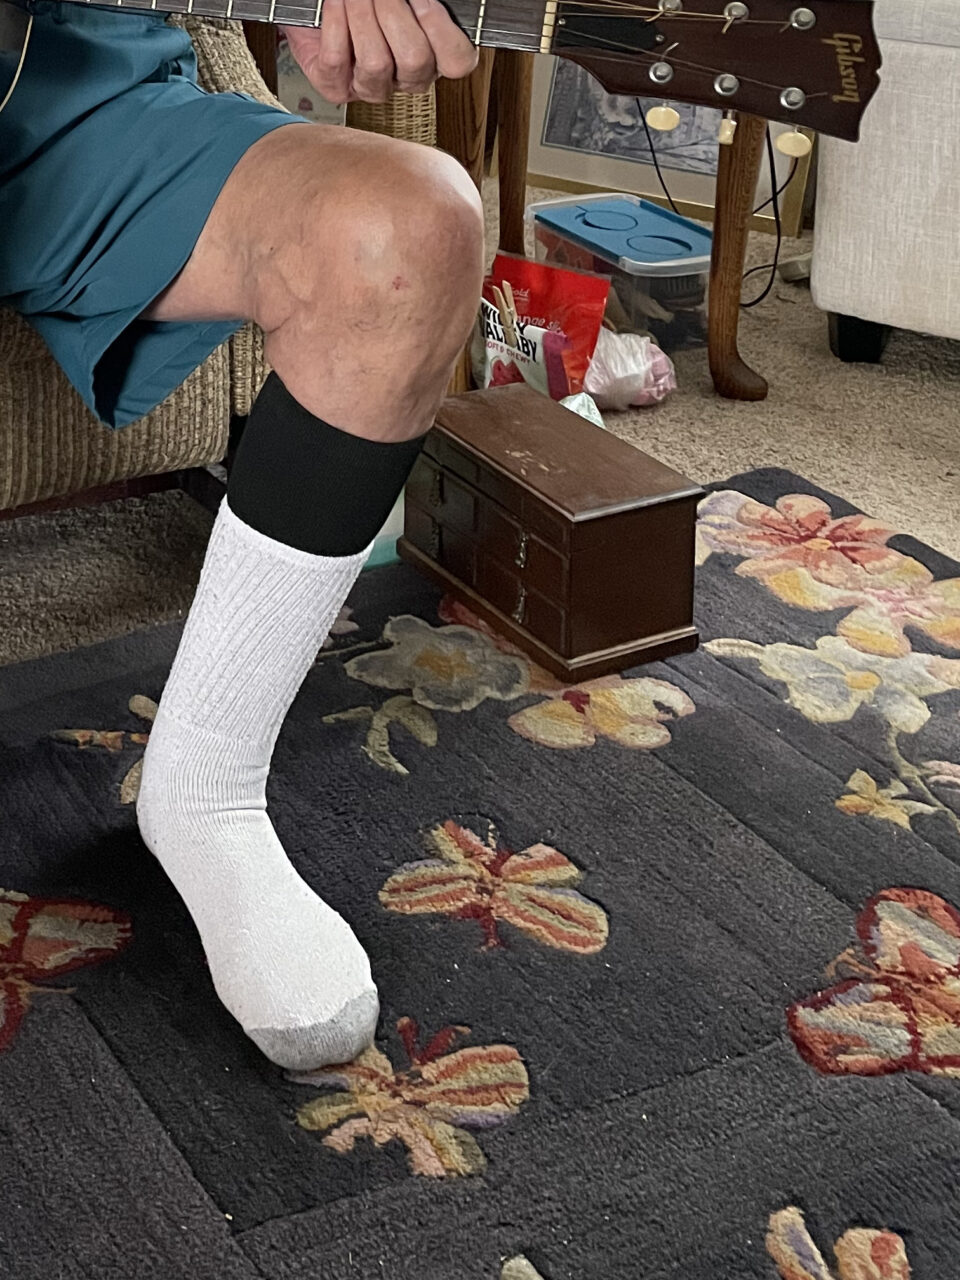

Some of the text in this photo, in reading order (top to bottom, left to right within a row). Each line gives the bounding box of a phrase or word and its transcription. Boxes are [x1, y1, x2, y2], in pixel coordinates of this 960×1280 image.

[821, 32, 866, 103] Gibson
[512, 287, 530, 298] old
[481, 302, 526, 335] WILY
[485, 340, 499, 351] OFT
[506, 348, 530, 363] CHEWY
